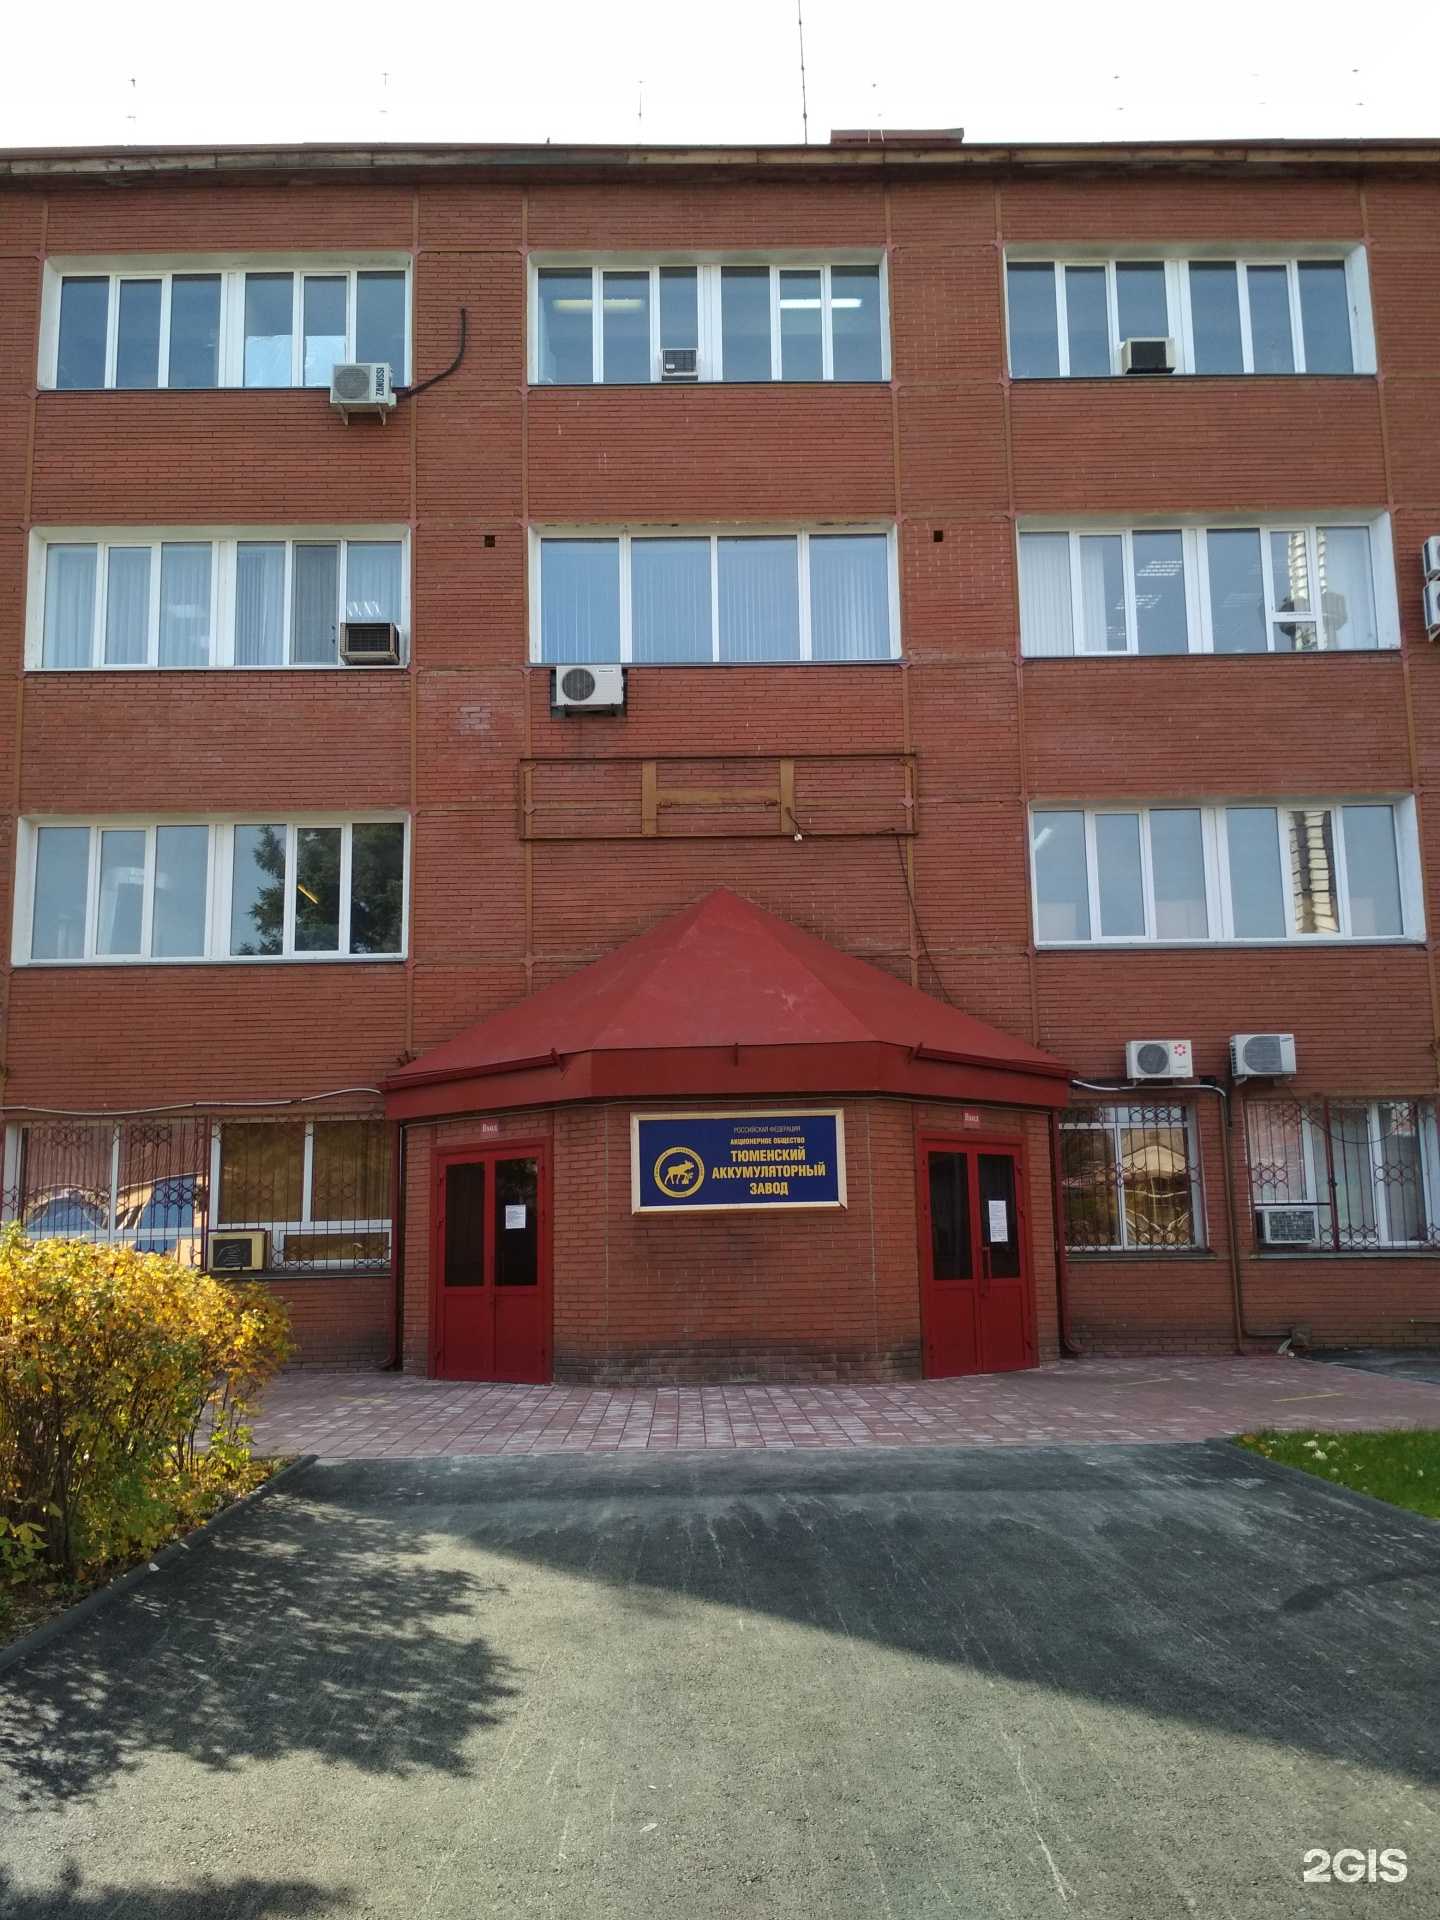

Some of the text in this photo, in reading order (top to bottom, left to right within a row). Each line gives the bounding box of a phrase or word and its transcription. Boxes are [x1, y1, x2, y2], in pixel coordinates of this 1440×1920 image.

[375, 367, 385, 397] ZANUSSI
[730, 1136, 805, 1145] АКЦИОНЕРНОЕ ОБЩЕСТВО
[730, 1146, 806, 1162] ТЮМЕНСКИЙ
[711, 1161, 826, 1179] АККУМУЛЯТОРНЫЙ
[749, 1182, 789, 1196] ЗАВОД
